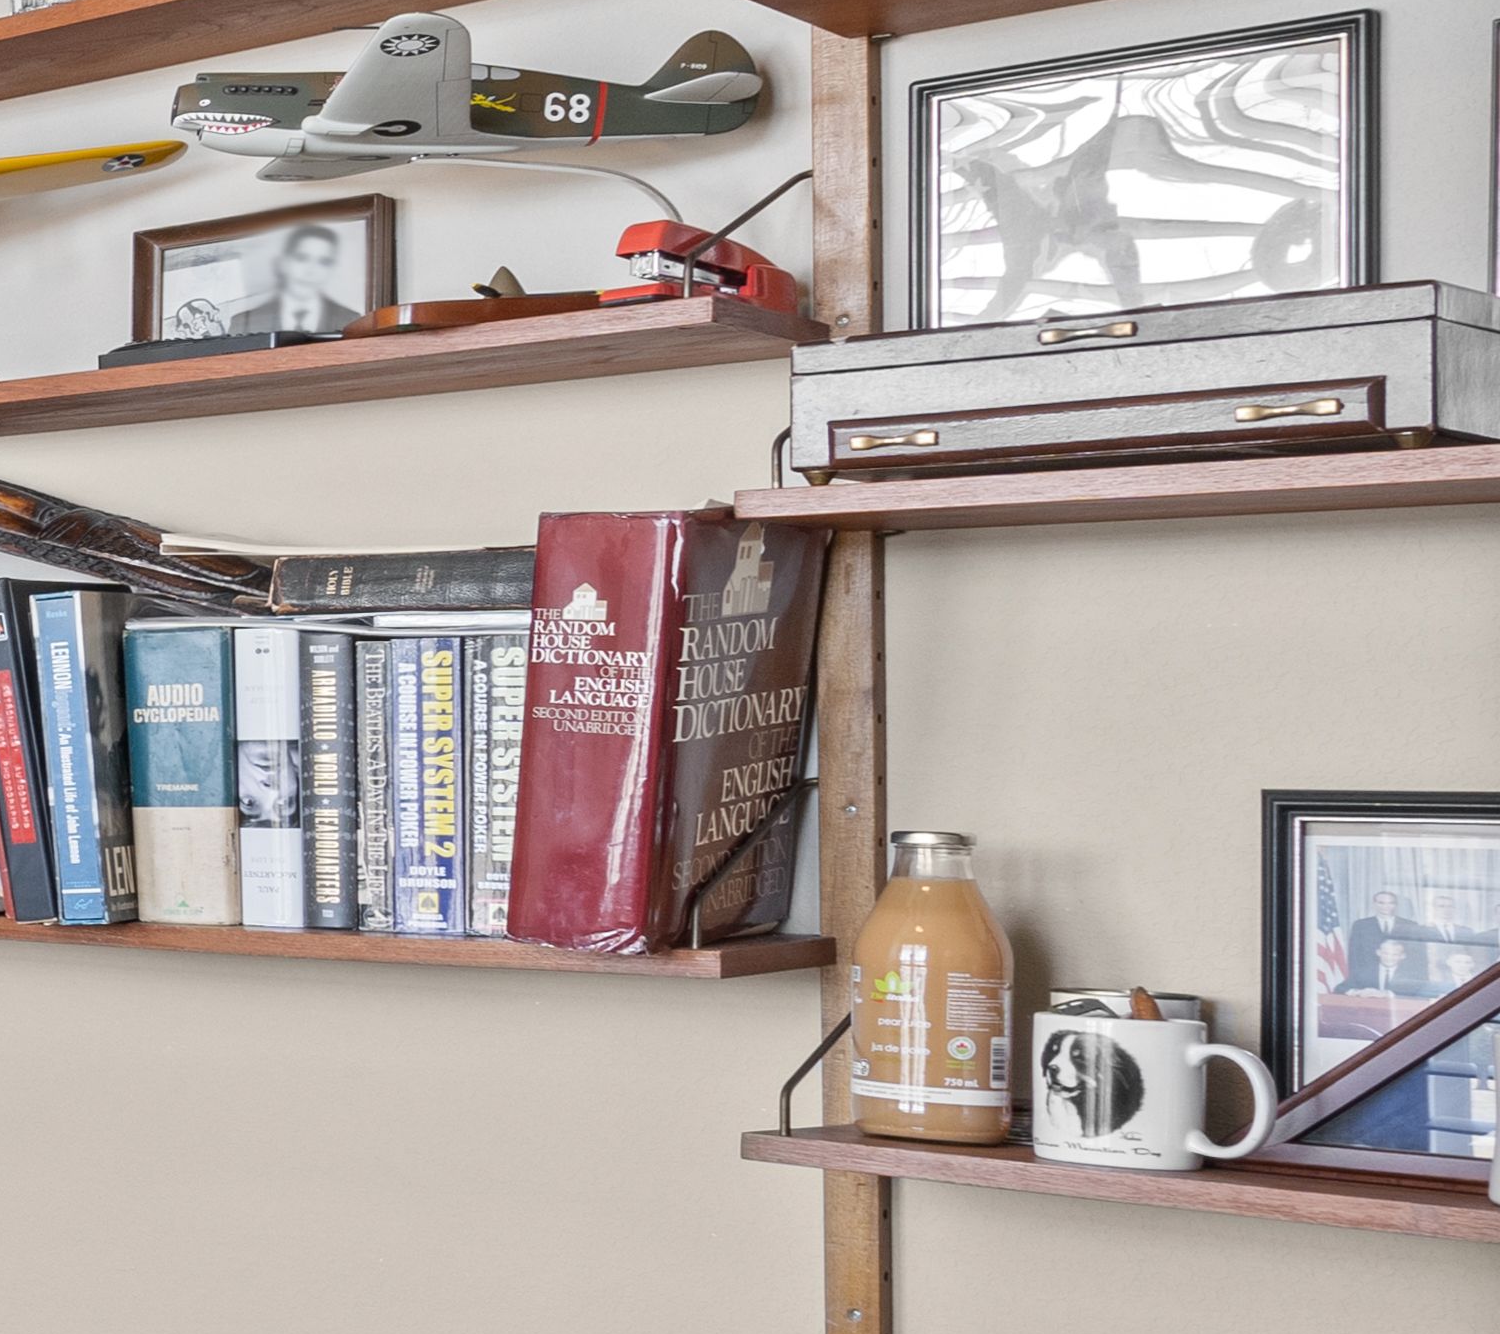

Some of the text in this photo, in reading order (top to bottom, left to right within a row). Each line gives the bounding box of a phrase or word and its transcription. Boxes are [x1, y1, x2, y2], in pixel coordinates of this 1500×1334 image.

[543, 92, 591, 124] 68
[326, 569, 339, 595] HOLY
[340, 566, 354, 596] BIBLE
[534, 607, 562, 620] THE
[682, 592, 721, 624] THE
[532, 634, 592, 649] HOUSE
[533, 620, 616, 636] RANDOM
[678, 616, 779, 662] RANDOM
[50, 641, 71, 689] LENNON
[365, 650, 385, 683] THE
[531, 649, 653, 667] DICTIONARY
[600, 666, 650, 679] OF THE
[146, 683, 204, 707] AUDIO
[574, 677, 650, 694] ENGLISH
[675, 659, 747, 702] HOUSE
[311, 669, 337, 741] ARMADILLO
[549, 689, 650, 708] LANGUAGE
[133, 707, 220, 724] CYCLOPEDIA
[366, 687, 385, 752] BEATLES
[532, 707, 648, 723] SECOND EDITION
[672, 684, 808, 744] DICTIONARY
[58, 733, 71, 745] An
[421, 649, 455, 858] SUPER SYSTEM 2
[491, 646, 526, 861] SUPER SYSTEM
[748, 725, 798, 759] OF THE
[59, 746, 75, 785] Illustrated
[367, 758, 386, 771] A
[398, 662, 419, 847] A COURSE IN POWER POKER
[473, 659, 487, 852] A COURSE IN POWER POKER
[156, 783, 199, 792] TREMAINE
[313, 753, 338, 796] WORLD
[720, 755, 796, 804] ENGLISH
[63, 787, 77, 802] Life
[367, 775, 387, 804] DAY
[65, 814, 79, 834] John
[67, 835, 81, 864] Lennon
[315, 808, 341, 904] HEADQUARTERS
[104, 844, 135, 897] LEN
[367, 865, 388, 896] LIFE
[399, 878, 457, 889] BRUNSON
[409, 865, 446, 876] DOYLE
[486, 873, 510, 881] DOYL
[706, 866, 786, 911] NABRIDGED
[944, 1077, 964, 1087] 750
